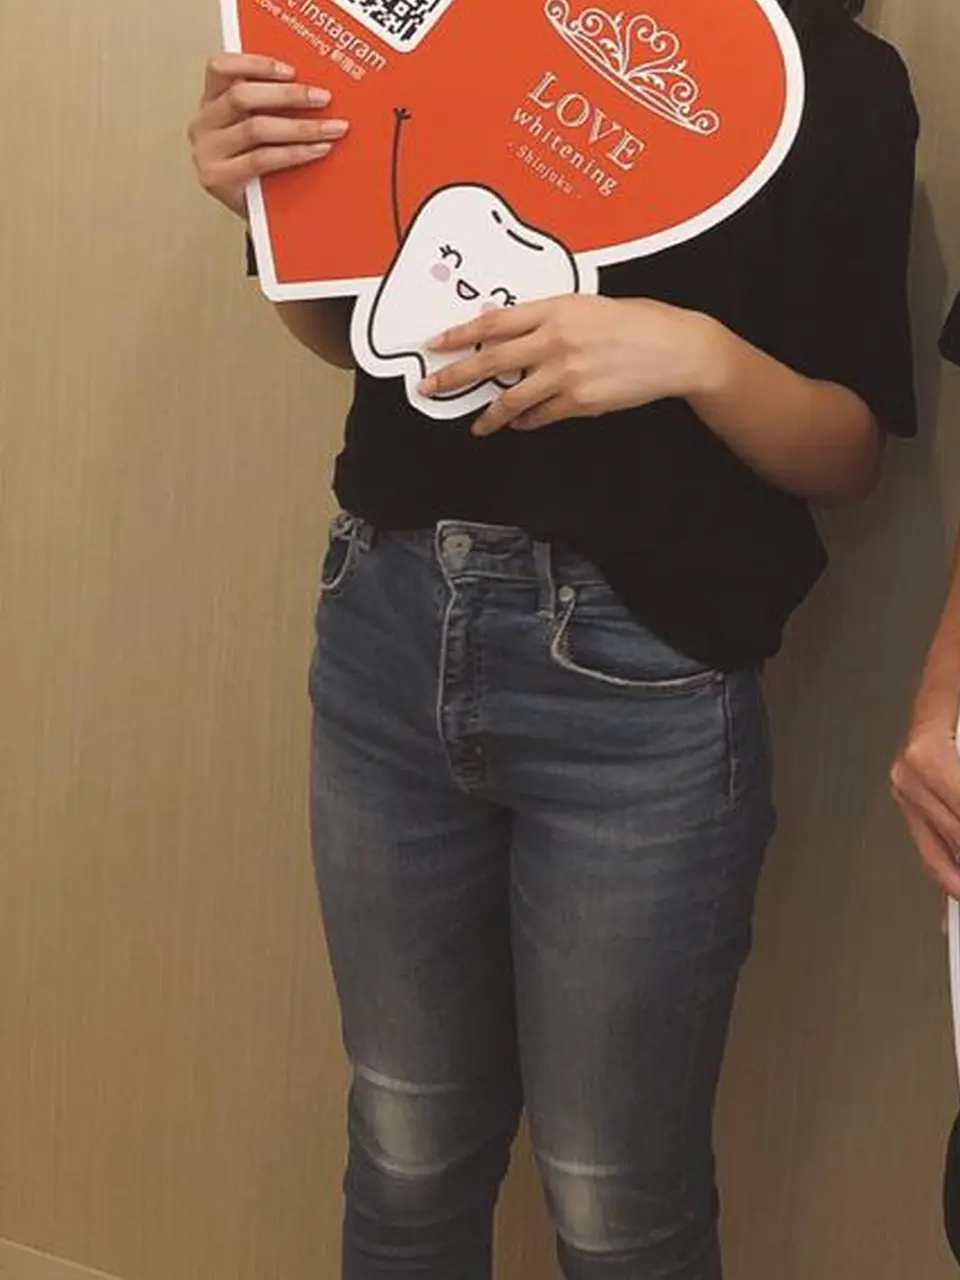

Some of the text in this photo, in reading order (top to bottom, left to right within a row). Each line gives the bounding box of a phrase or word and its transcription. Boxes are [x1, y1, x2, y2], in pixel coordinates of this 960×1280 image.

[512, 108, 618, 196] whitening
[528, 71, 646, 170] LOVE
[516, 144, 574, 195] Shinjuku
